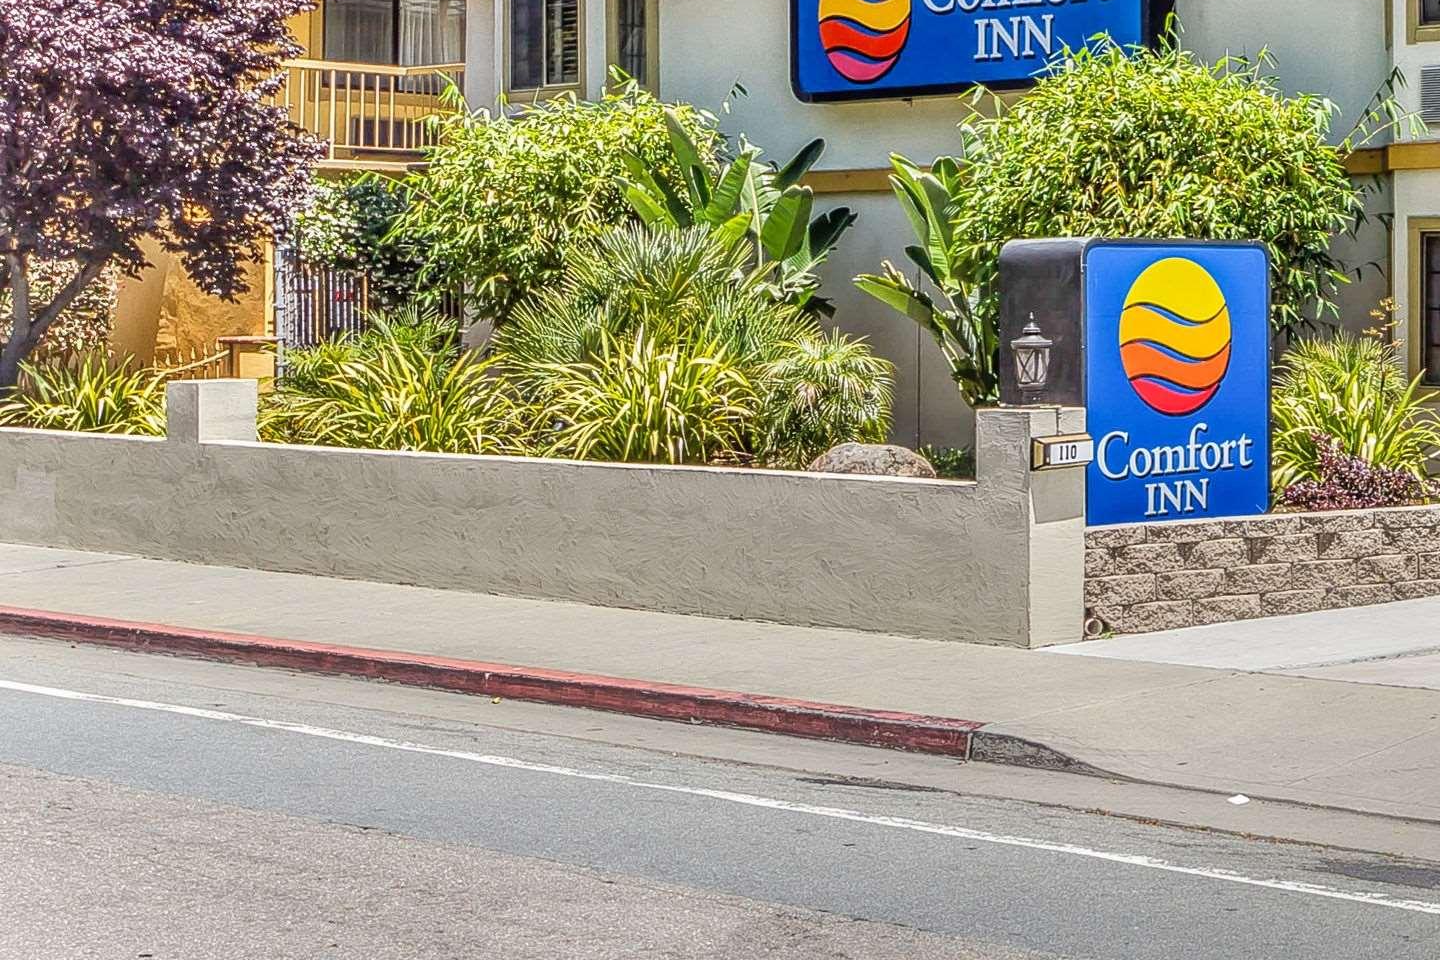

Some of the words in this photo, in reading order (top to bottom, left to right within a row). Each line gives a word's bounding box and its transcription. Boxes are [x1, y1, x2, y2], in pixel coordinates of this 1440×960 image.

[973, 14, 1055, 60] INN
[1060, 444, 1077, 460] 110
[1096, 423, 1253, 480] Comfort
[1144, 478, 1210, 516] INN
